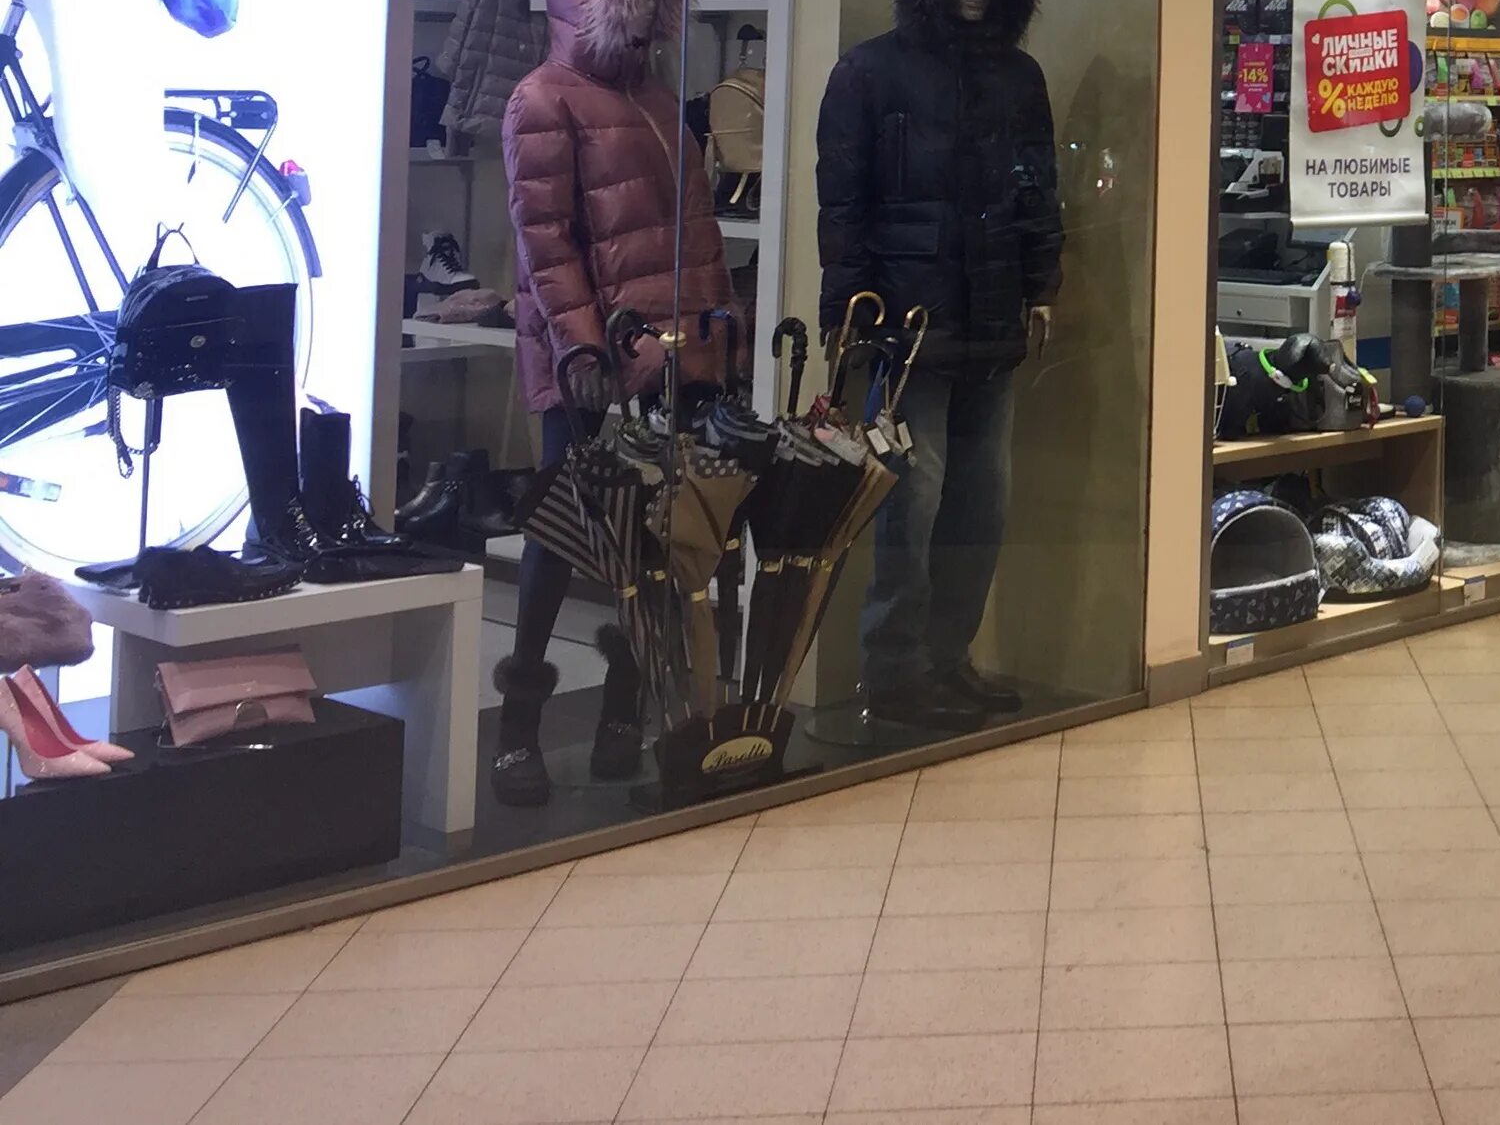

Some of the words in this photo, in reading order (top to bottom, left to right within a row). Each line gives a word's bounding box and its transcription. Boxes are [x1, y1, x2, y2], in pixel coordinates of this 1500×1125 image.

[1321, 28, 1398, 57] ЛИЧНЫЕ
[1322, 48, 1399, 77] СКИДКИ
[1239, 68, 1269, 83] -14%
[1346, 77, 1399, 97] КАЖДУЮ
[1347, 91, 1399, 112] НЕДЕЛЮ
[1305, 159, 1328, 176] НА
[1331, 157, 1411, 175] ЛЮБИМЫЕ
[1328, 181, 1392, 198] ТОВАРЫ
